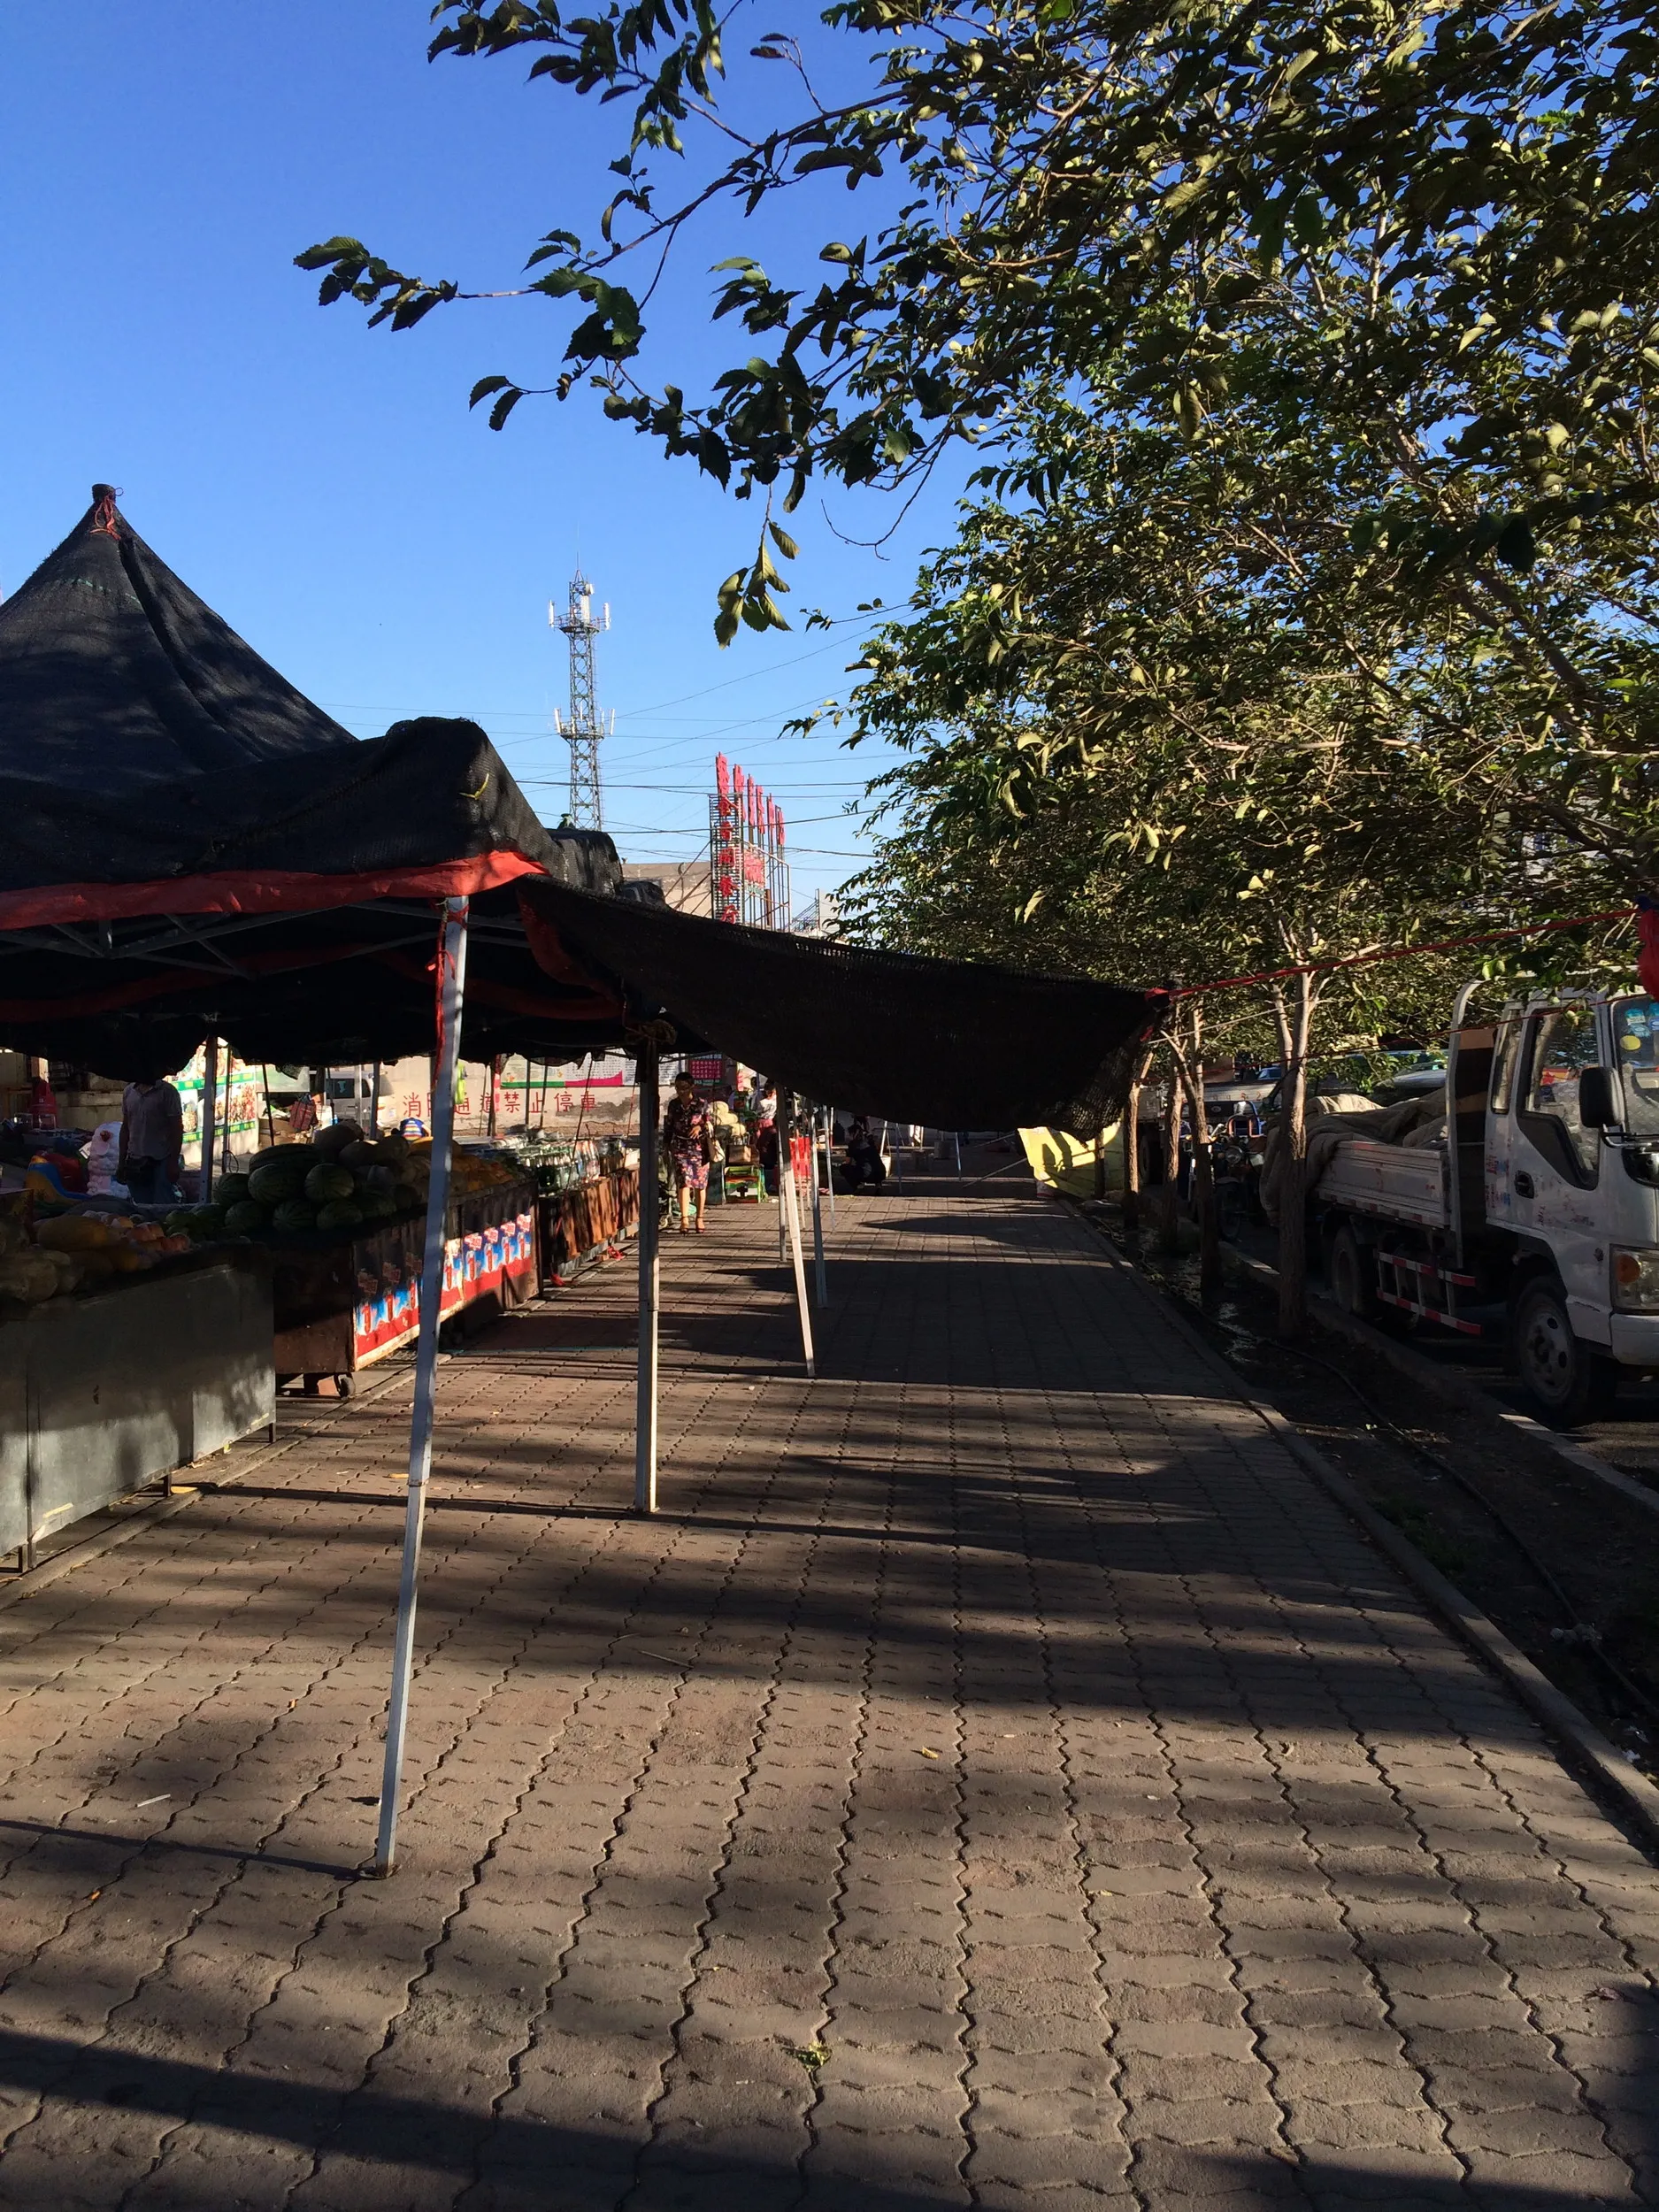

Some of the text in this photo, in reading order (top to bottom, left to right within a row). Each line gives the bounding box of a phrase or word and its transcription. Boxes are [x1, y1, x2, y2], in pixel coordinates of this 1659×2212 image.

[403, 1090, 595, 1118] 消通道禁止停車
